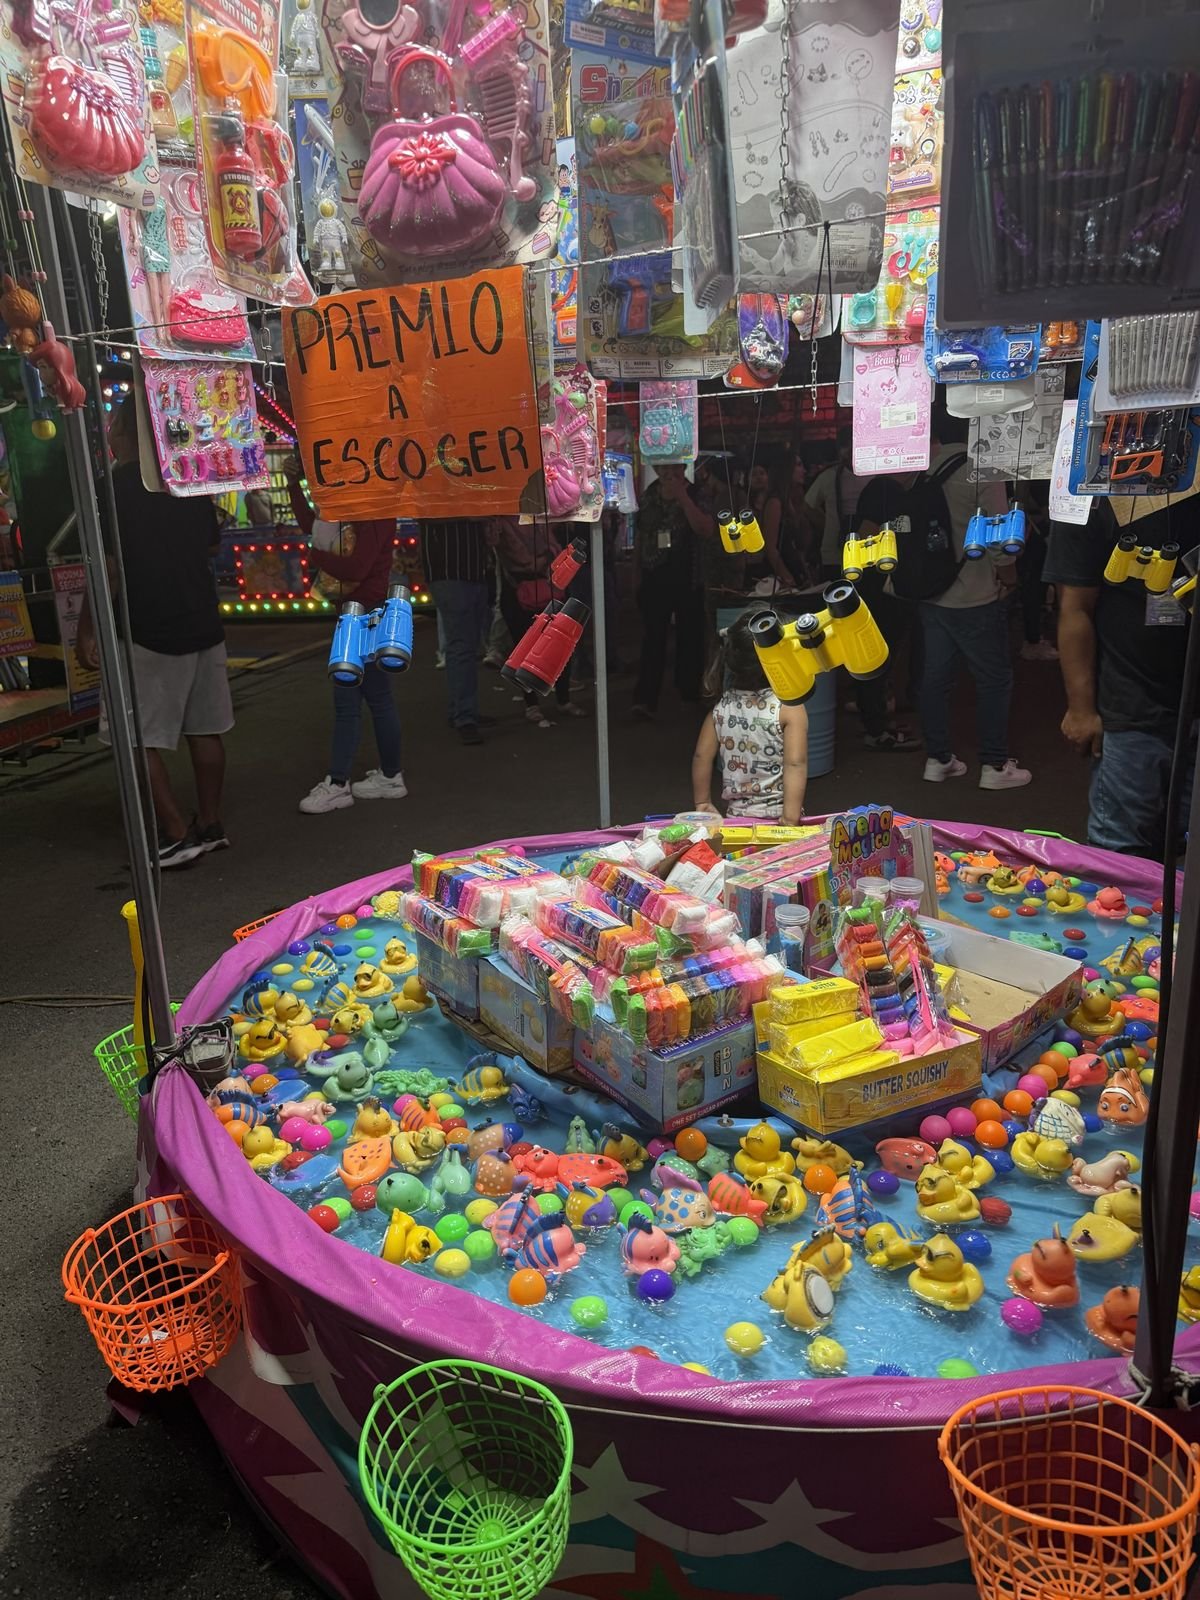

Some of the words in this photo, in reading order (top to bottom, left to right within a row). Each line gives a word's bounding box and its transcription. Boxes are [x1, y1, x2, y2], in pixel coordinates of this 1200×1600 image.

[291, 281, 504, 375] PREMIO
[925, 294, 936, 341] REFINE
[388, 384, 409, 420] A
[312, 426, 530, 488] ESCOGER
[833, 810, 892, 849] Arena
[862, 1074, 904, 1102] BUTTER
[906, 1060, 949, 1090] SQUISHY
